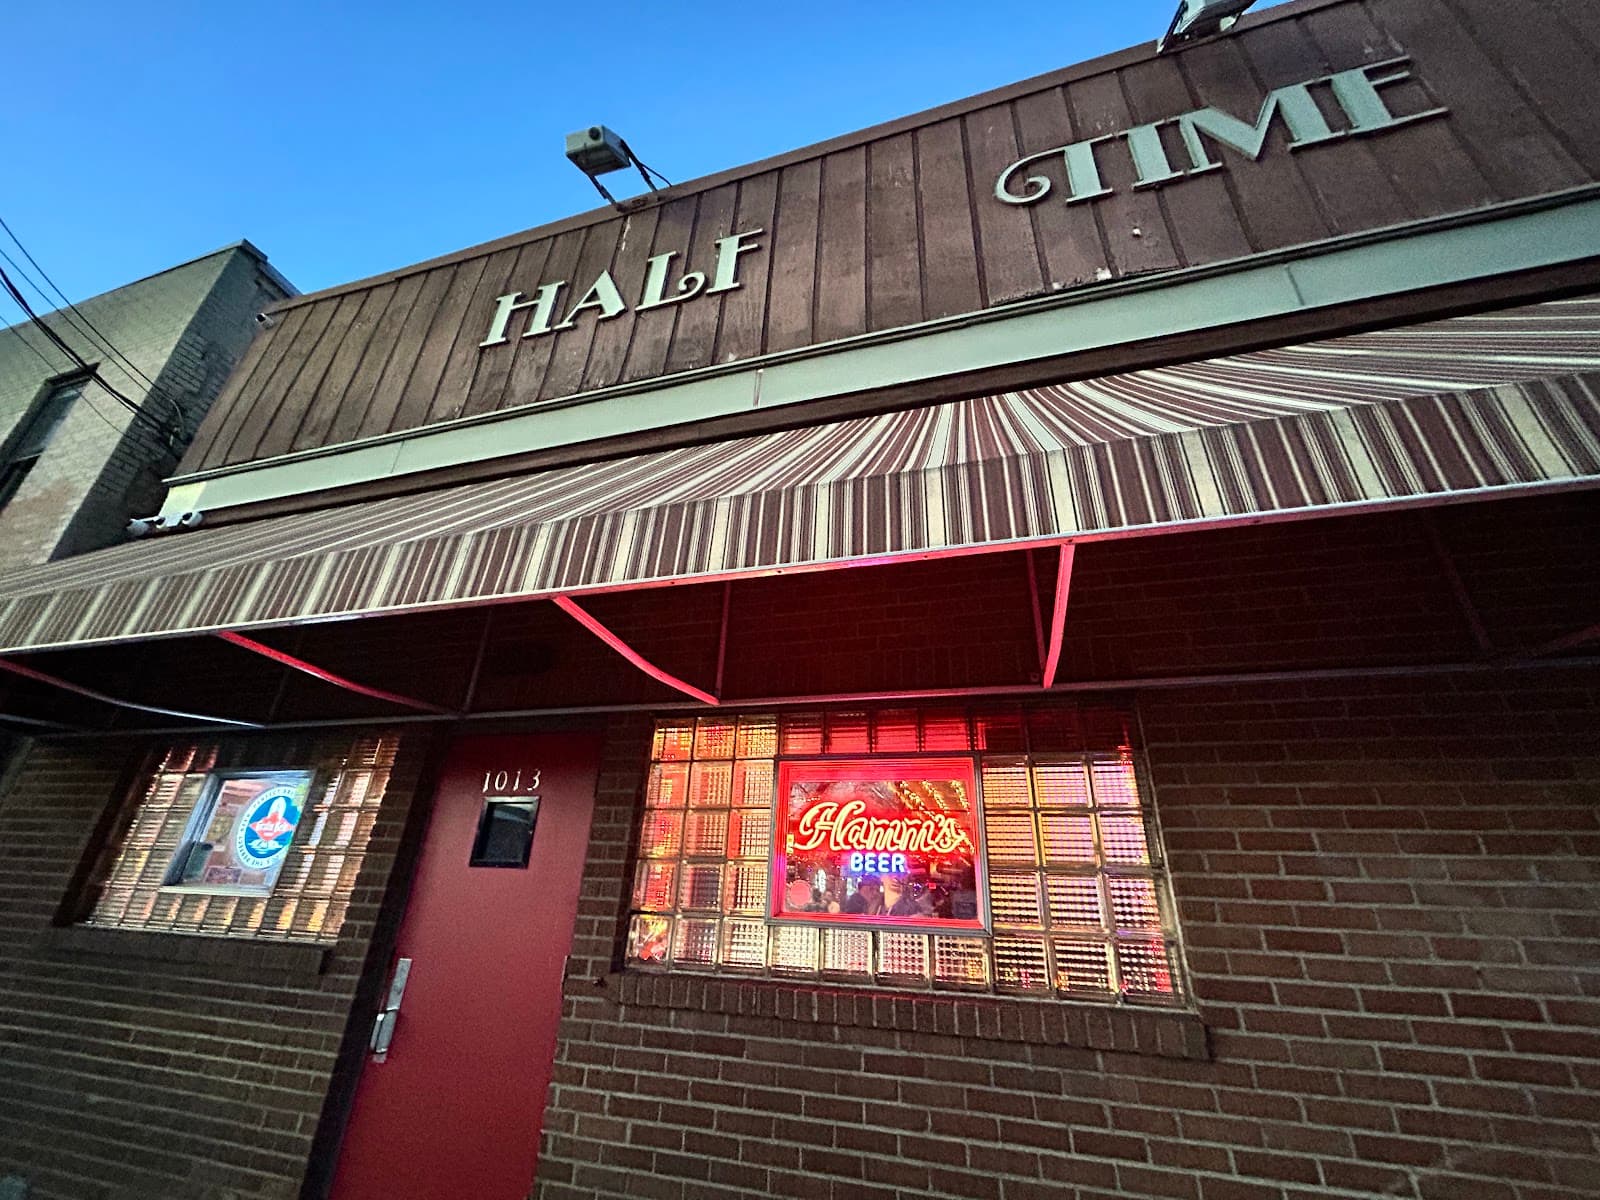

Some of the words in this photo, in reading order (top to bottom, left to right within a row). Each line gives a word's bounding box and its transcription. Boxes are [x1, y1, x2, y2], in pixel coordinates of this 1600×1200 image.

[479, 228, 763, 348] HALF
[994, 55, 1449, 205] TIME
[482, 768, 541, 793] 1013
[792, 800, 967, 853] Hamm's
[850, 853, 906, 873] BEER
